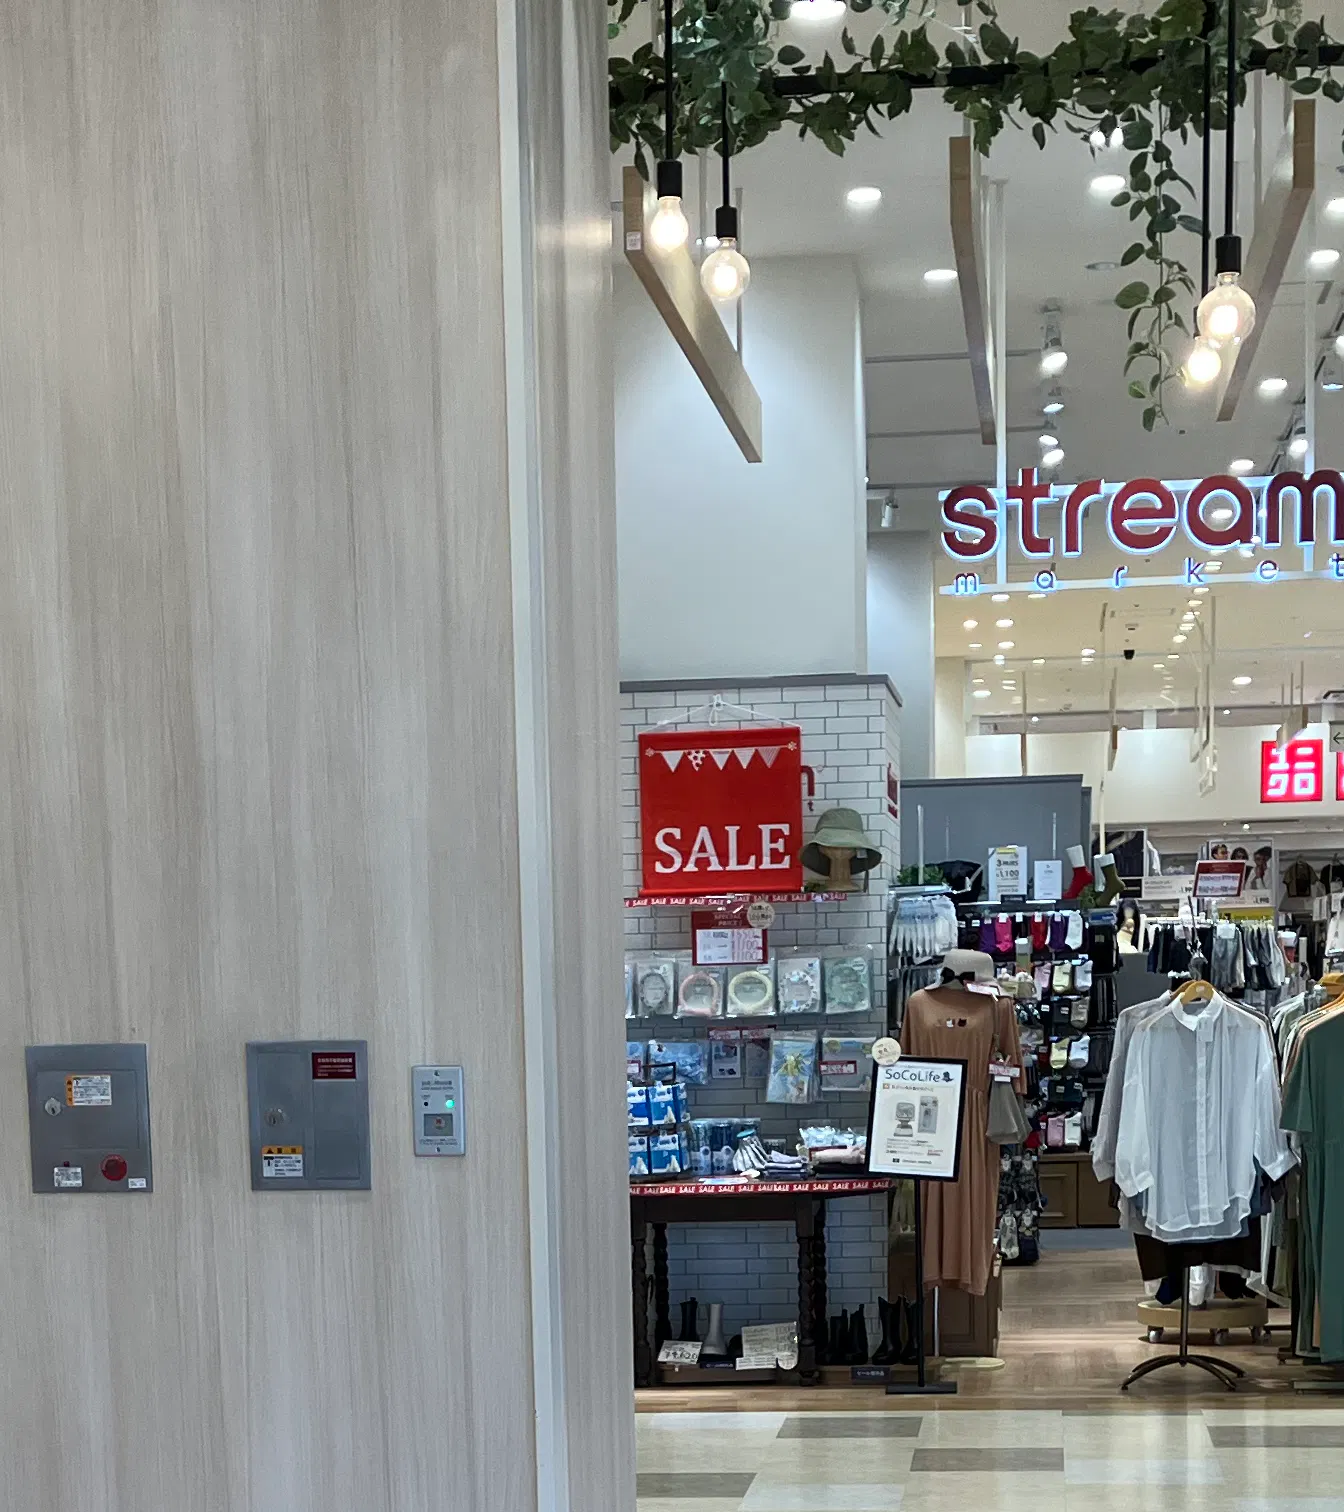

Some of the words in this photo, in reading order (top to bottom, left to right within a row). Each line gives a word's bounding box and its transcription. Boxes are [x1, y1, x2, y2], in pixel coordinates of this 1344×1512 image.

[1266, 772, 1316, 796] クロ
[654, 823, 791, 874] SALE
[884, 1067, 941, 1083] SoCoLife
[679, 1185, 695, 1193] SALE
[698, 1185, 715, 1193] SALE
[718, 1185, 735, 1193] SALE
[738, 1184, 754, 1192] SALE
[757, 1184, 774, 1192] SALE
[793, 1183, 809, 1191] SALE
[813, 1183, 829, 1191] SALE
[832, 1182, 849, 1190] SALE
[852, 1181, 869, 1189] SALE
[872, 1180, 889, 1188] SALE
